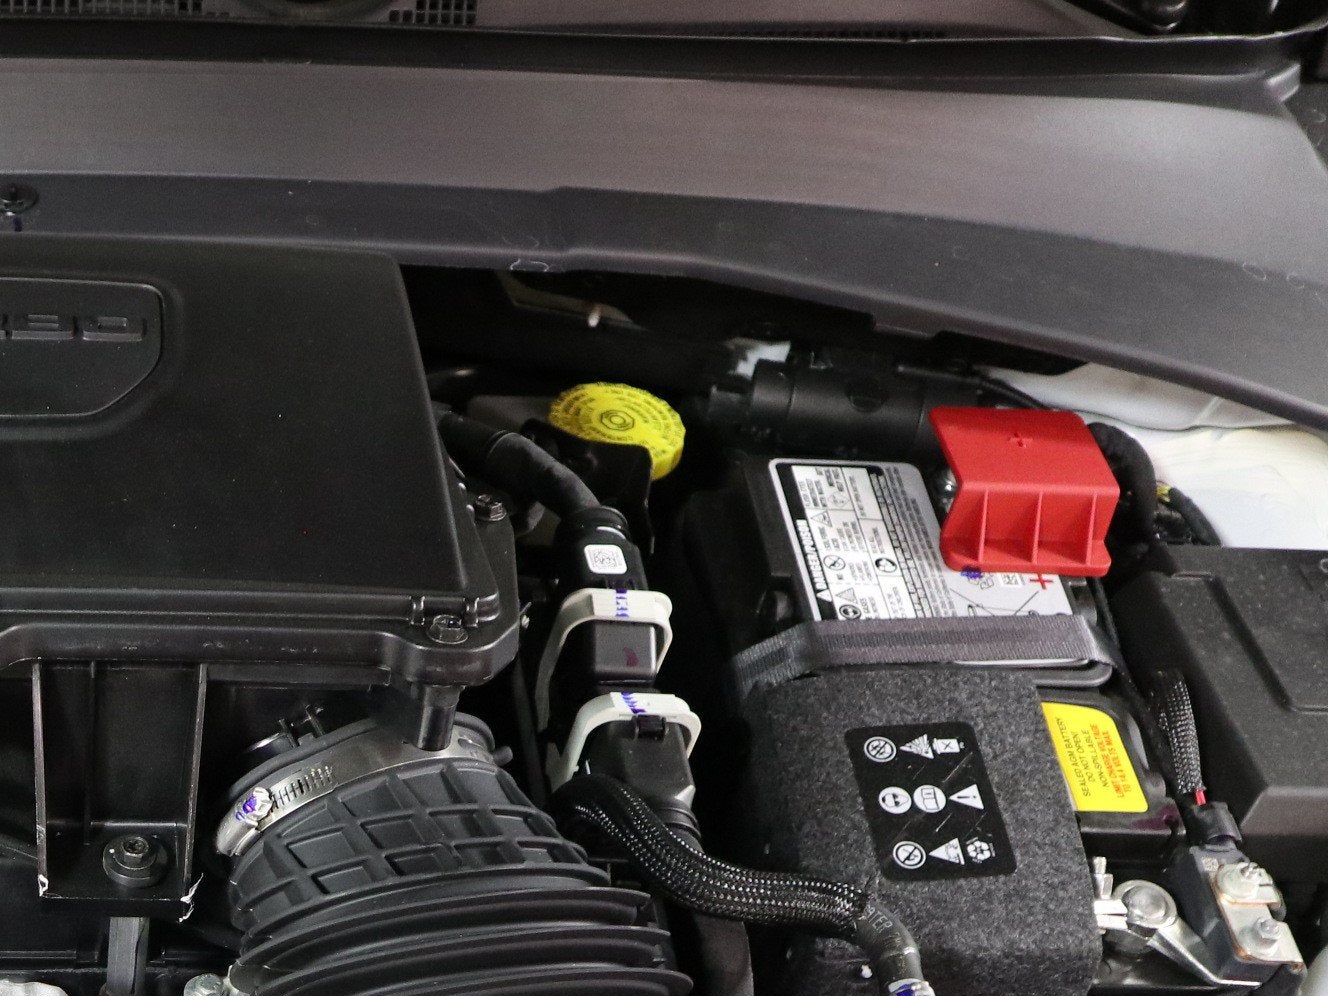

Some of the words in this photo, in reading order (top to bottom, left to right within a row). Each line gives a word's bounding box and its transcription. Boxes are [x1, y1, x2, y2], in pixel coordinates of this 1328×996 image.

[1055, 717, 1073, 748] BATTERY
[1067, 750, 1079, 767] AGM
[1074, 768, 1091, 797] SEALED
